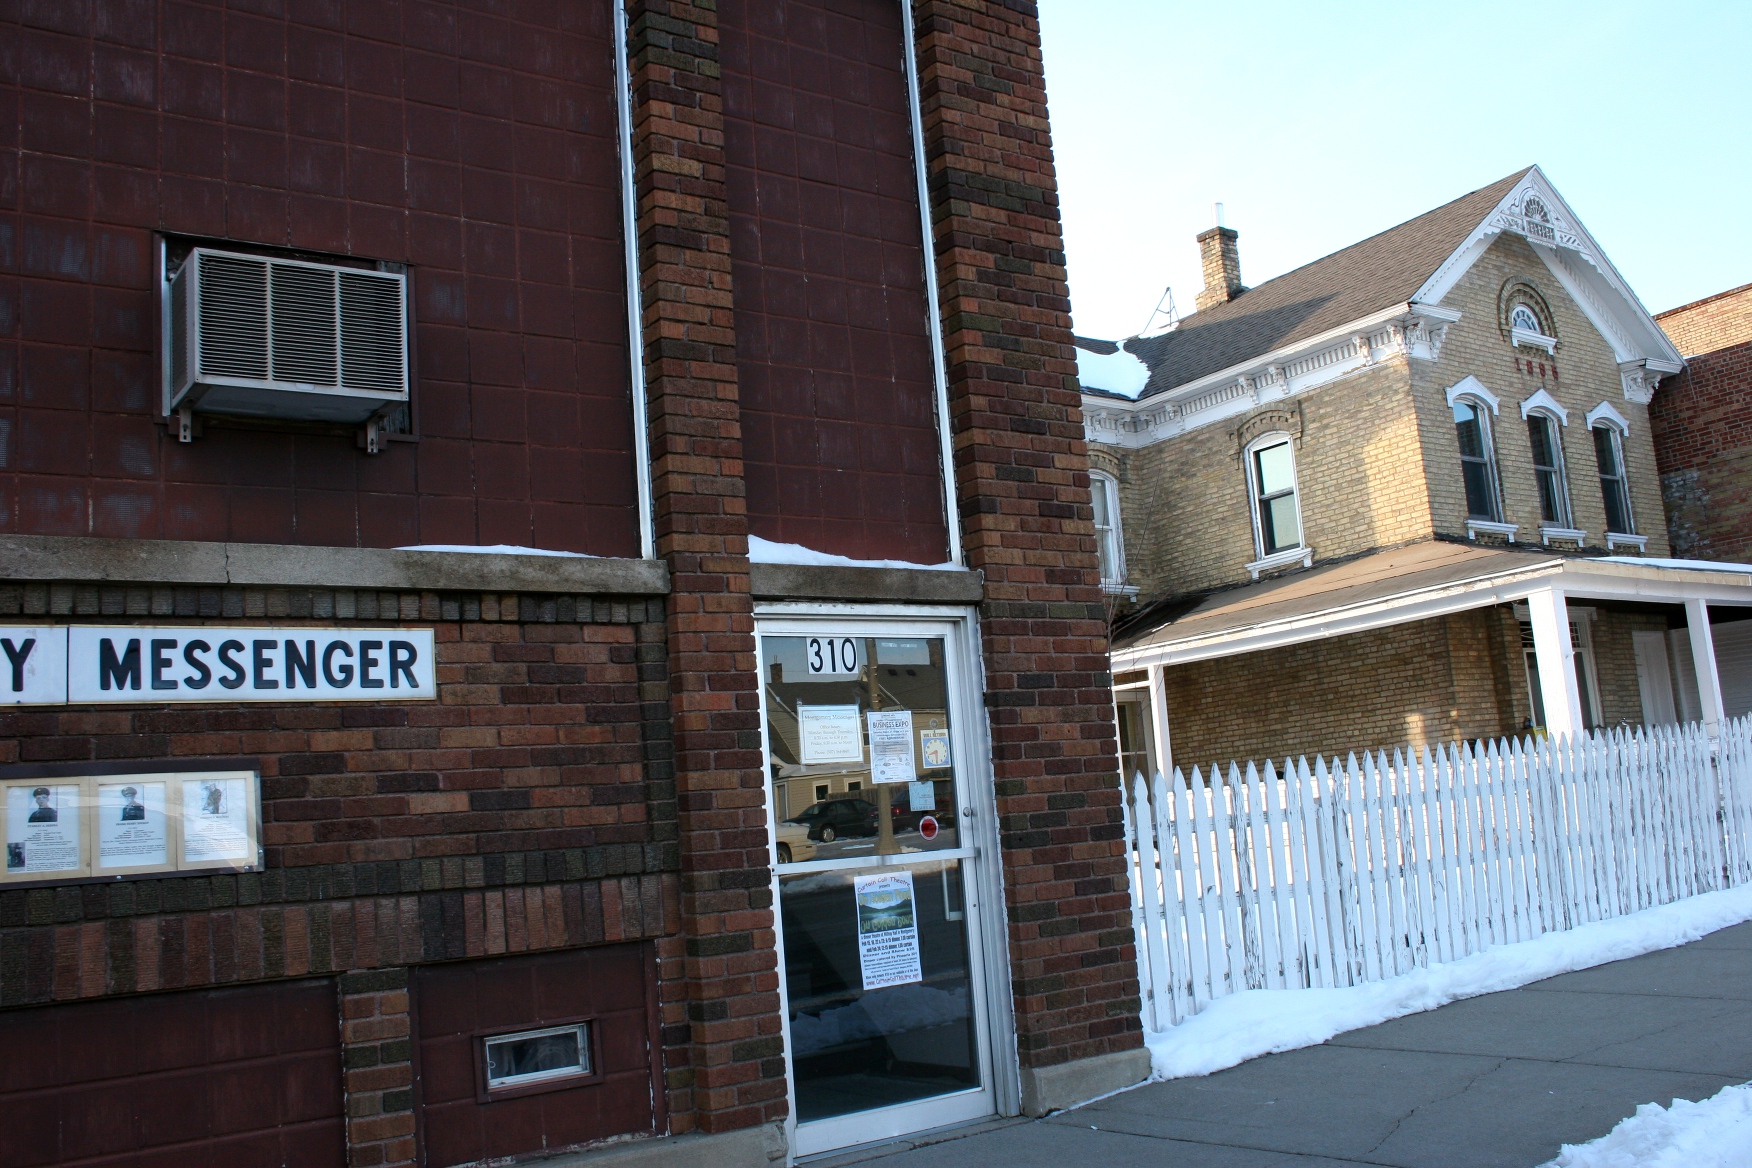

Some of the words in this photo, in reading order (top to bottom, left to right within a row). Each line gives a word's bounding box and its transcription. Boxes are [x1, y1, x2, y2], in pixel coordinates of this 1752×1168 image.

[0, 638, 37, 692] Y
[99, 638, 420, 690] MESSENGER
[810, 638, 857, 673] 310
[873, 721, 895, 729] BUSINESS
[895, 720, 909, 728] EXPO
[857, 880, 877, 893] Curtain
[889, 876, 911, 888] Theatre
